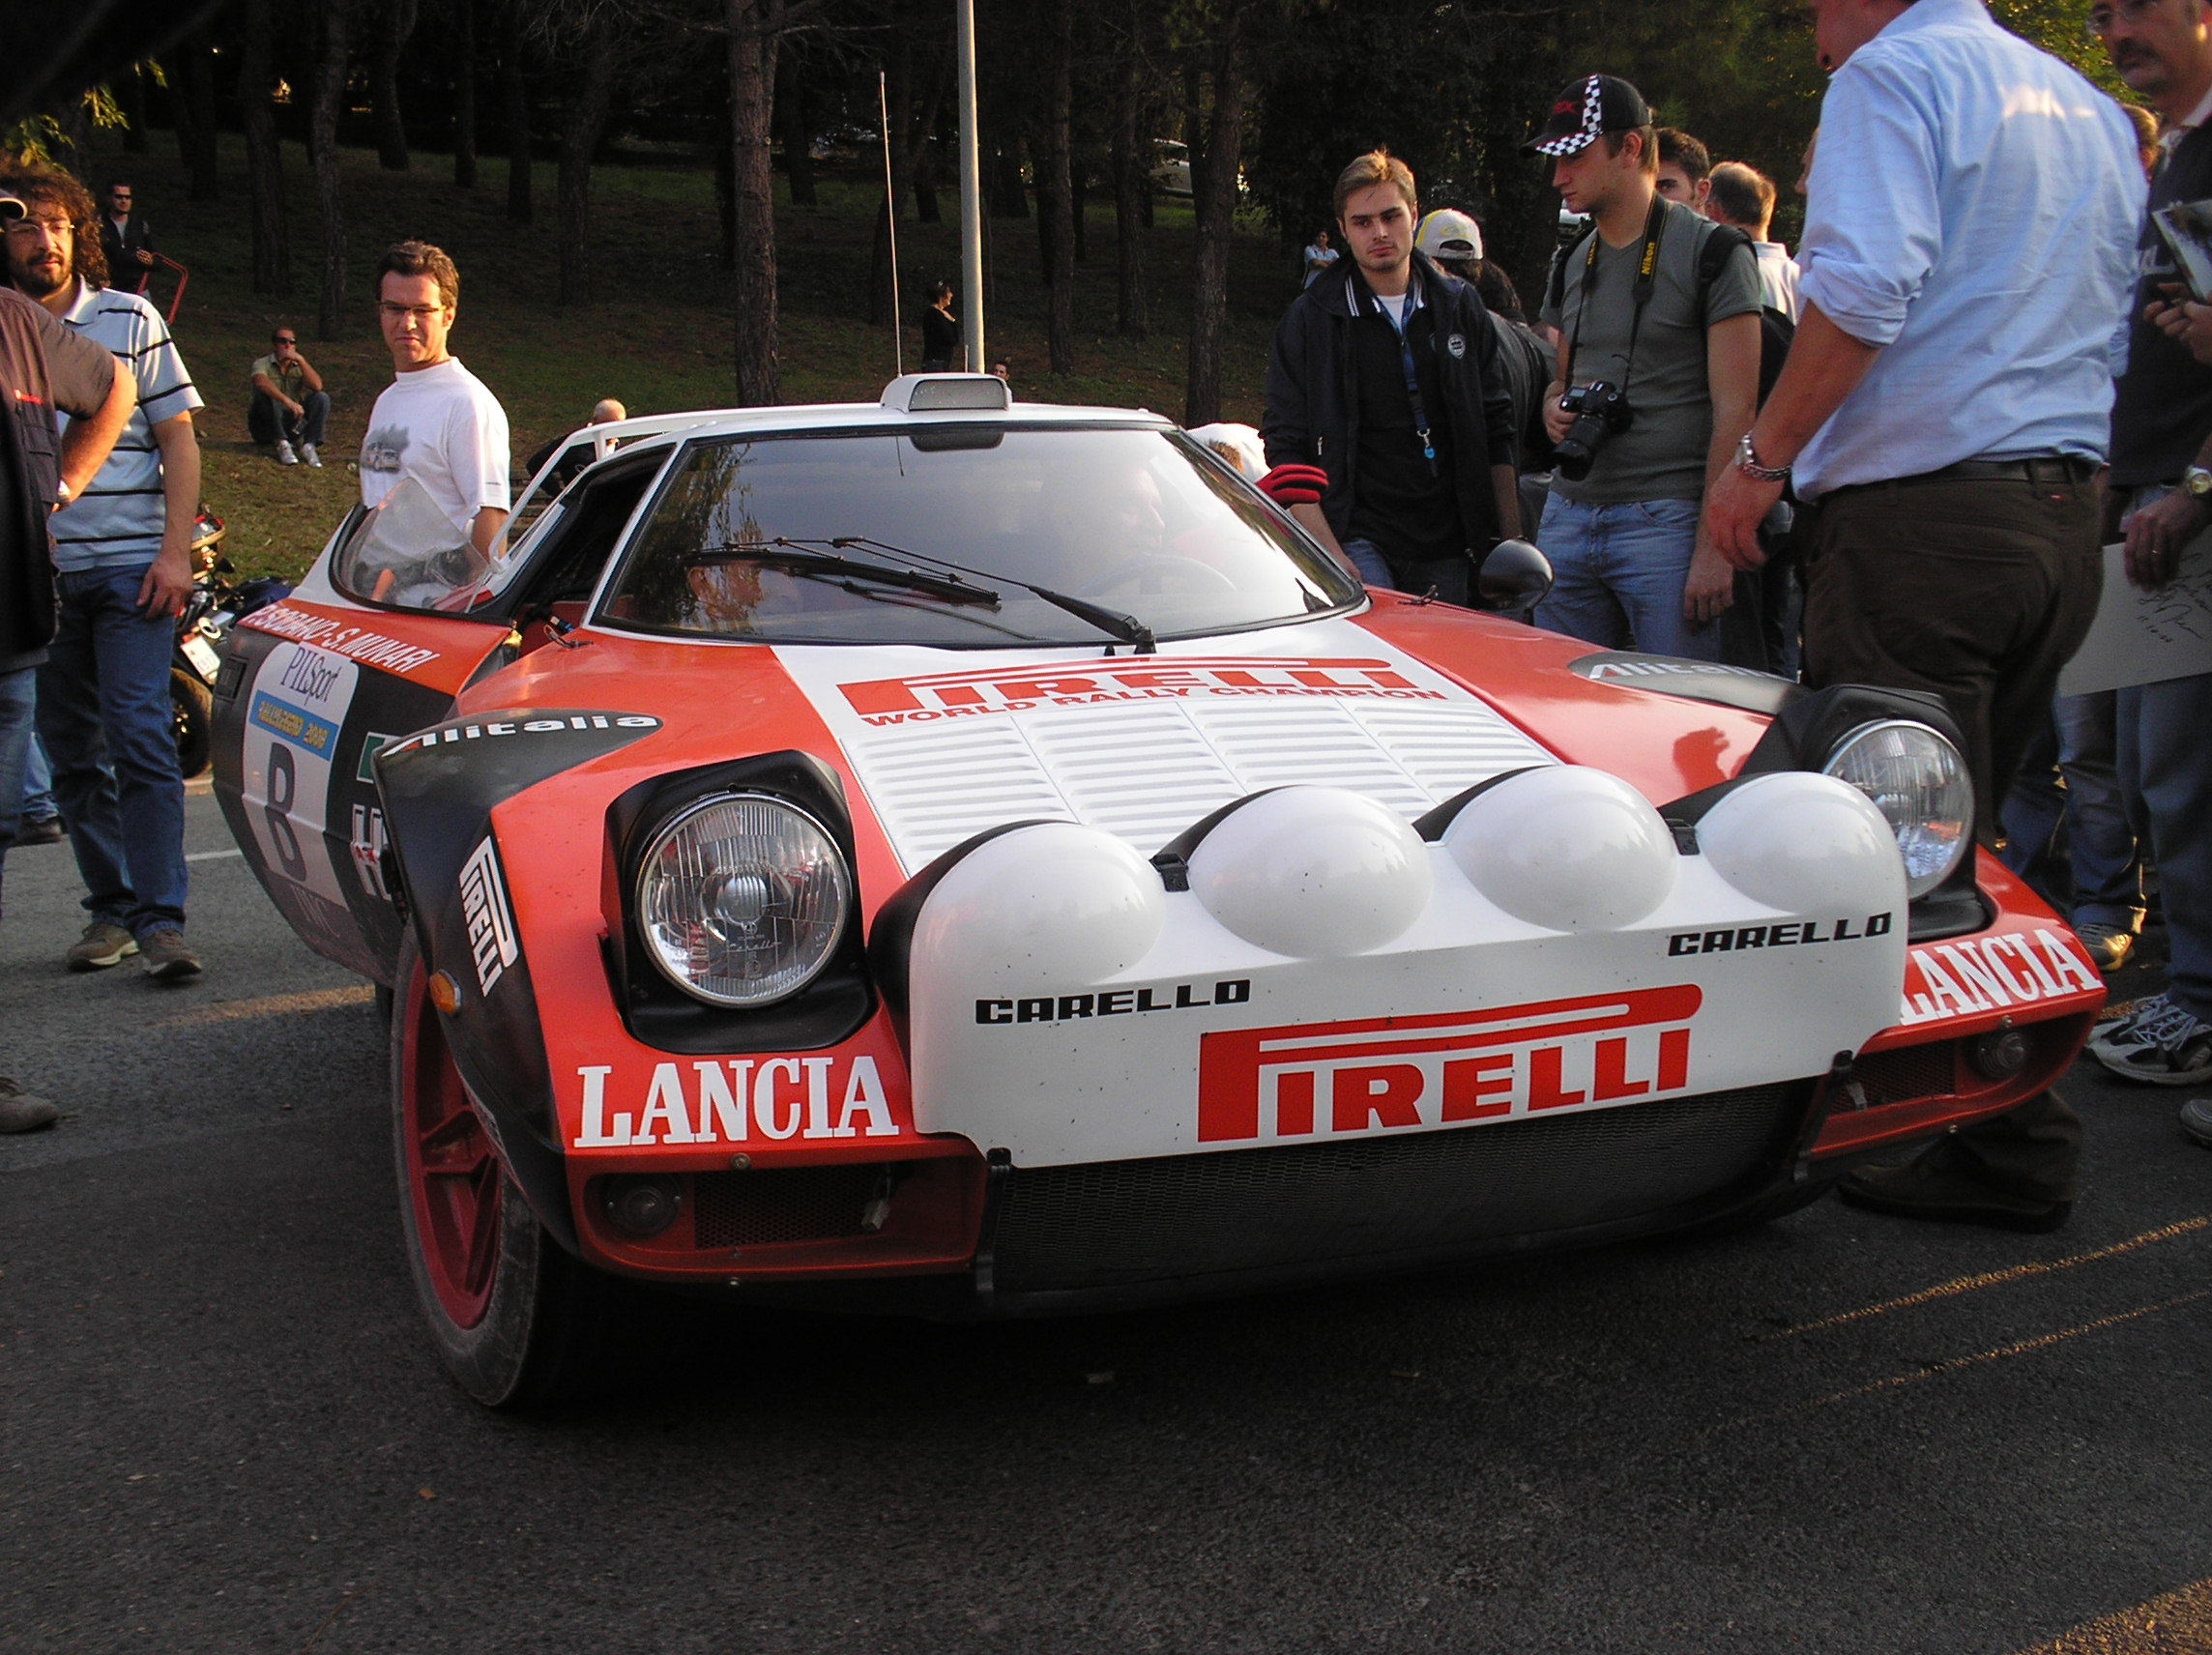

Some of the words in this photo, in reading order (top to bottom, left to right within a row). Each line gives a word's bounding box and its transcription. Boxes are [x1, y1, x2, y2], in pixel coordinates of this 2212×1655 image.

[1640, 242, 1656, 276] Nikon
[836, 657, 1419, 716] PIRELLI
[860, 701, 1037, 727] WORLD
[1052, 687, 1190, 707] RALLY
[1208, 686, 1448, 701] CHAMPION
[381, 715, 658, 757] Alitalia
[458, 834, 519, 998] PIRELLI
[1667, 912, 1892, 957] CARELLO
[975, 978, 1251, 1025] CARELLO
[1900, 929, 2104, 1027] LANCIA
[1198, 983, 1703, 1143] PIRELLI
[573, 1055, 900, 1148] LANCIA
